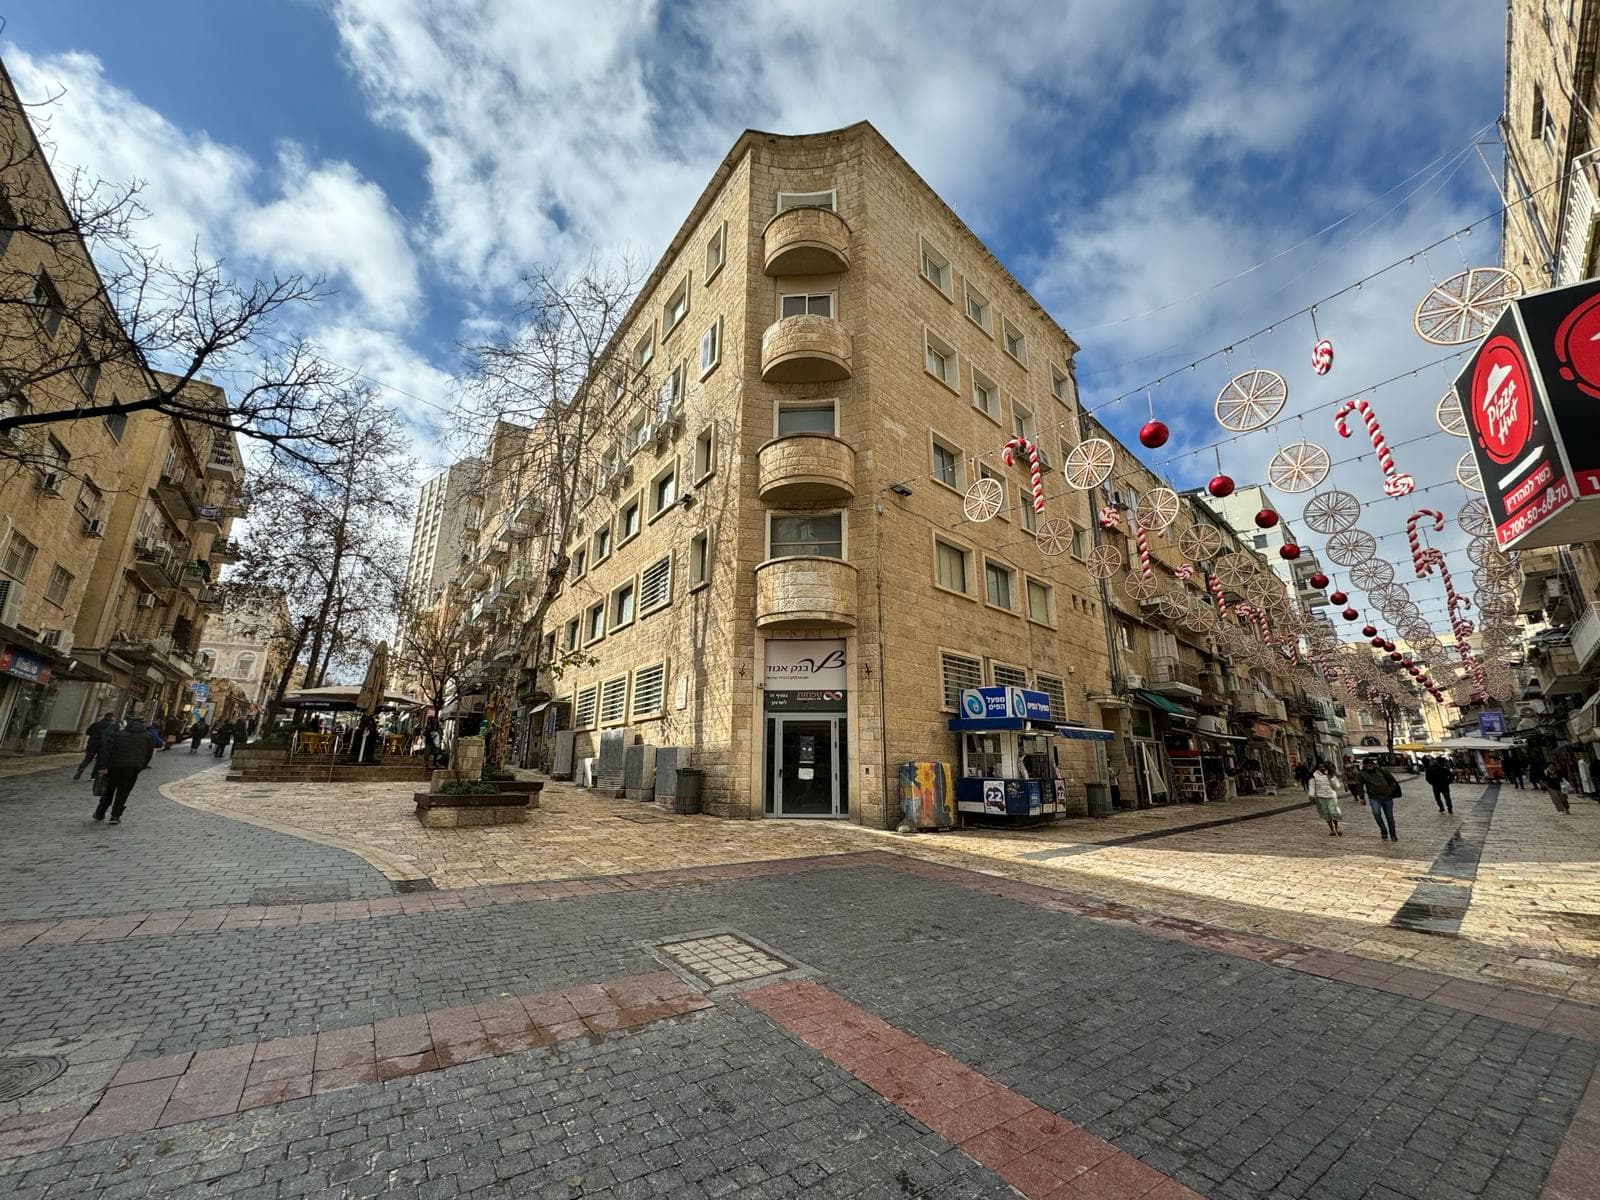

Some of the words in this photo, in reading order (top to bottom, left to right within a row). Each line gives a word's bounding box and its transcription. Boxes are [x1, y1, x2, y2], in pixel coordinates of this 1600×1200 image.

[1487, 380, 1517, 436] Pizza
[1498, 397, 1518, 445] Hut
[1534, 466, 1551, 485] כשר
[1505, 479, 1534, 512] למהדרין
[791, 664, 809, 673] בנק
[1026, 702, 1038, 710] הפיס
[1037, 702, 1050, 712] מפעל
[987, 791, 1002, 802] 22
[1057, 790, 1065, 800] 22
